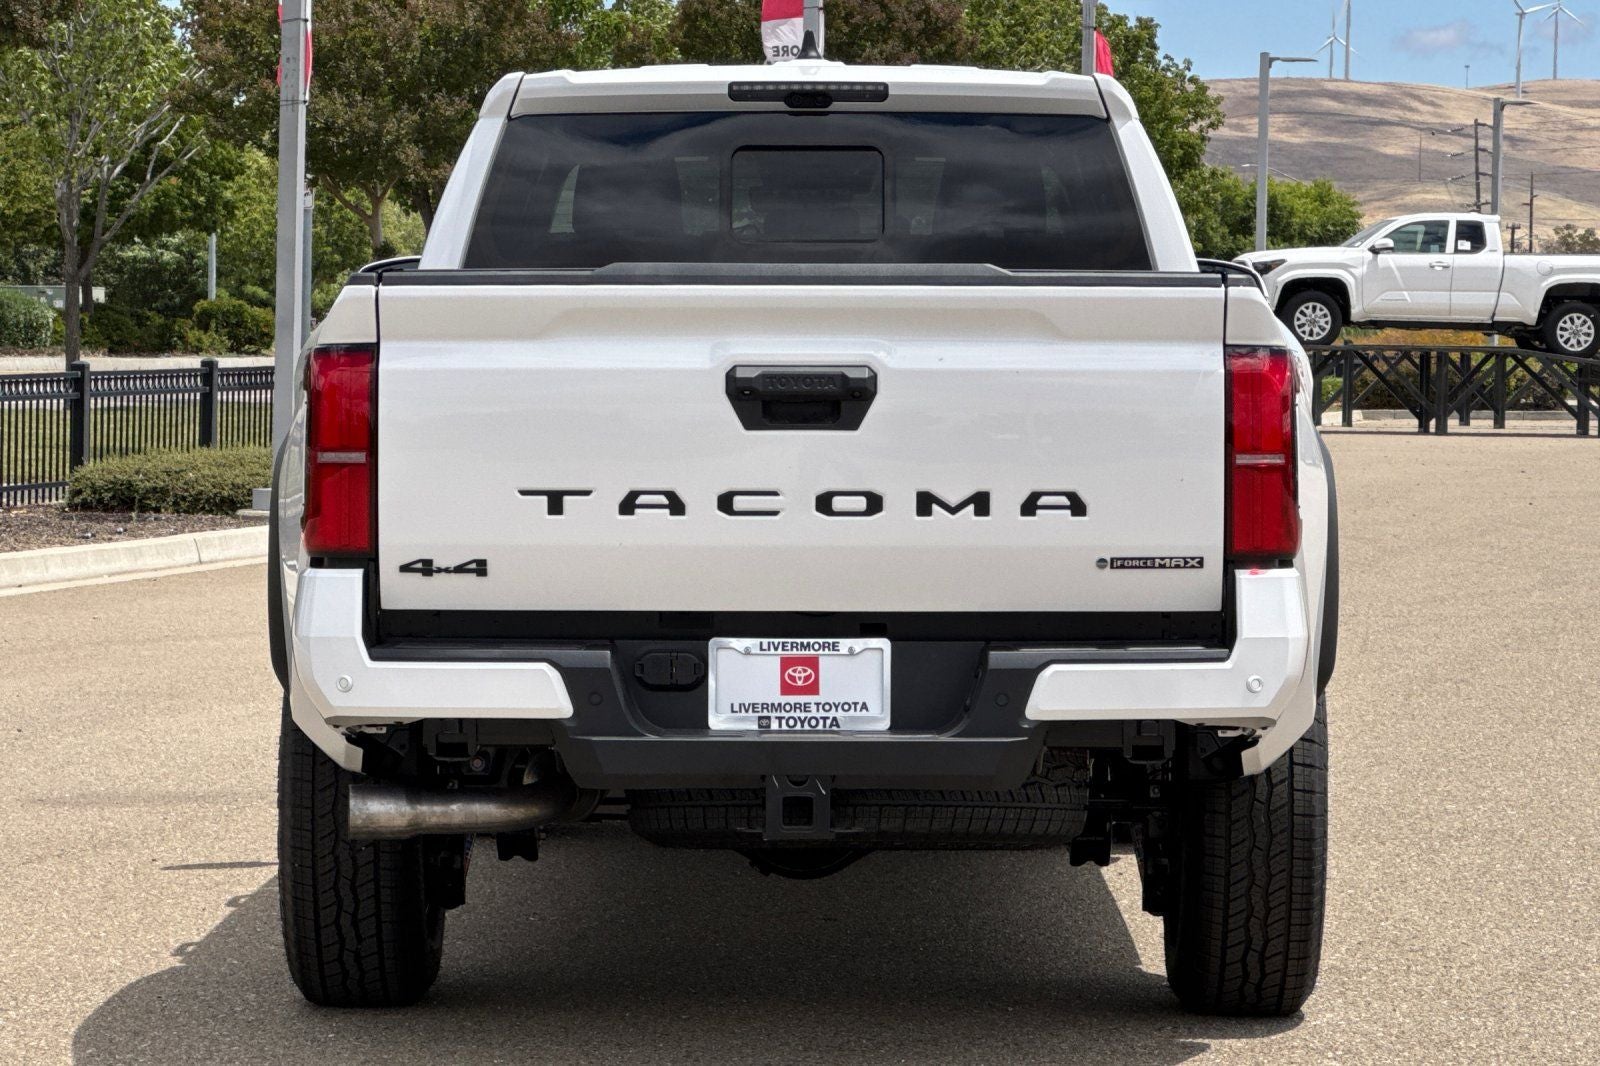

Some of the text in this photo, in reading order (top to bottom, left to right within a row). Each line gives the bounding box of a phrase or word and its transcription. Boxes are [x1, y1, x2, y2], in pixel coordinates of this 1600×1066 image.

[766, 377, 837, 389] TOYOTA
[517, 489, 1088, 517] TACOMA
[759, 641, 840, 652] LIVERMORE
[730, 702, 869, 713] LIVERMORE TOYOTA
[775, 716, 840, 729] TOYOTA
